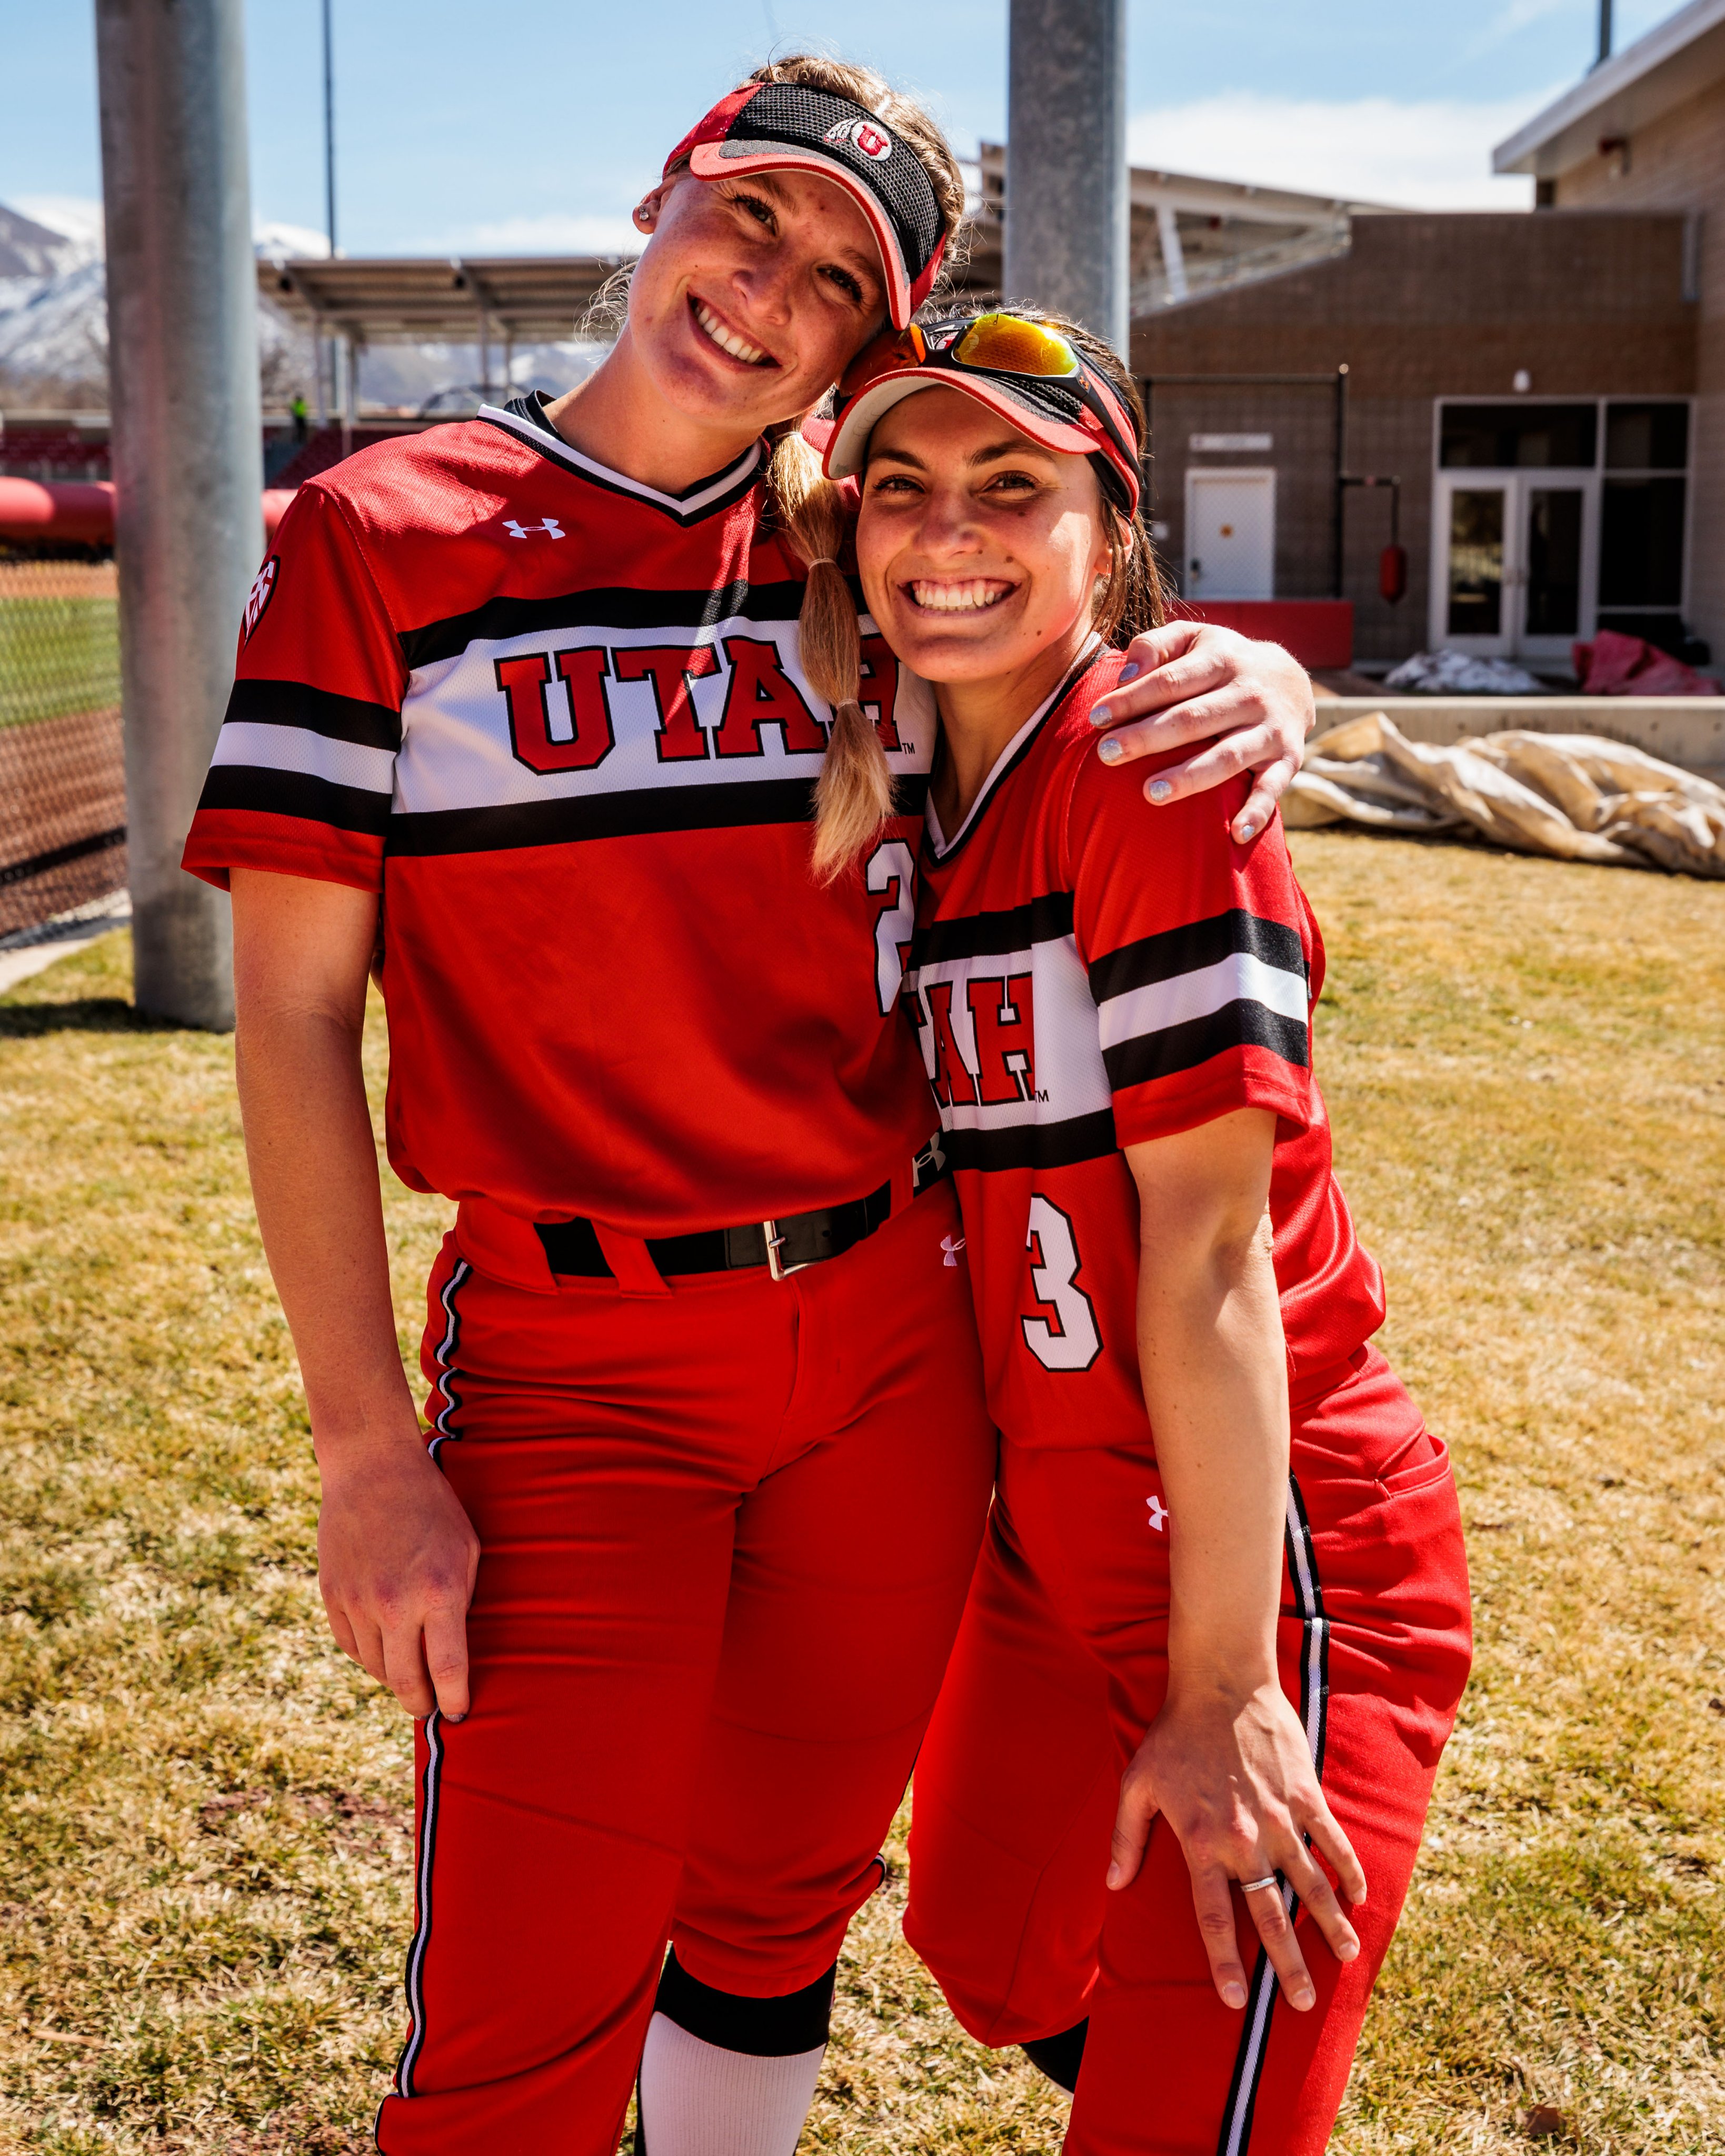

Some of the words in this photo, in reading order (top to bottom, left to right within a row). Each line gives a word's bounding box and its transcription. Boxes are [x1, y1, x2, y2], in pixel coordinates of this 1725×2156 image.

[857, 124, 889, 156] U
[902, 743, 915, 755] TM
[1021, 1193, 1104, 1372] 3
